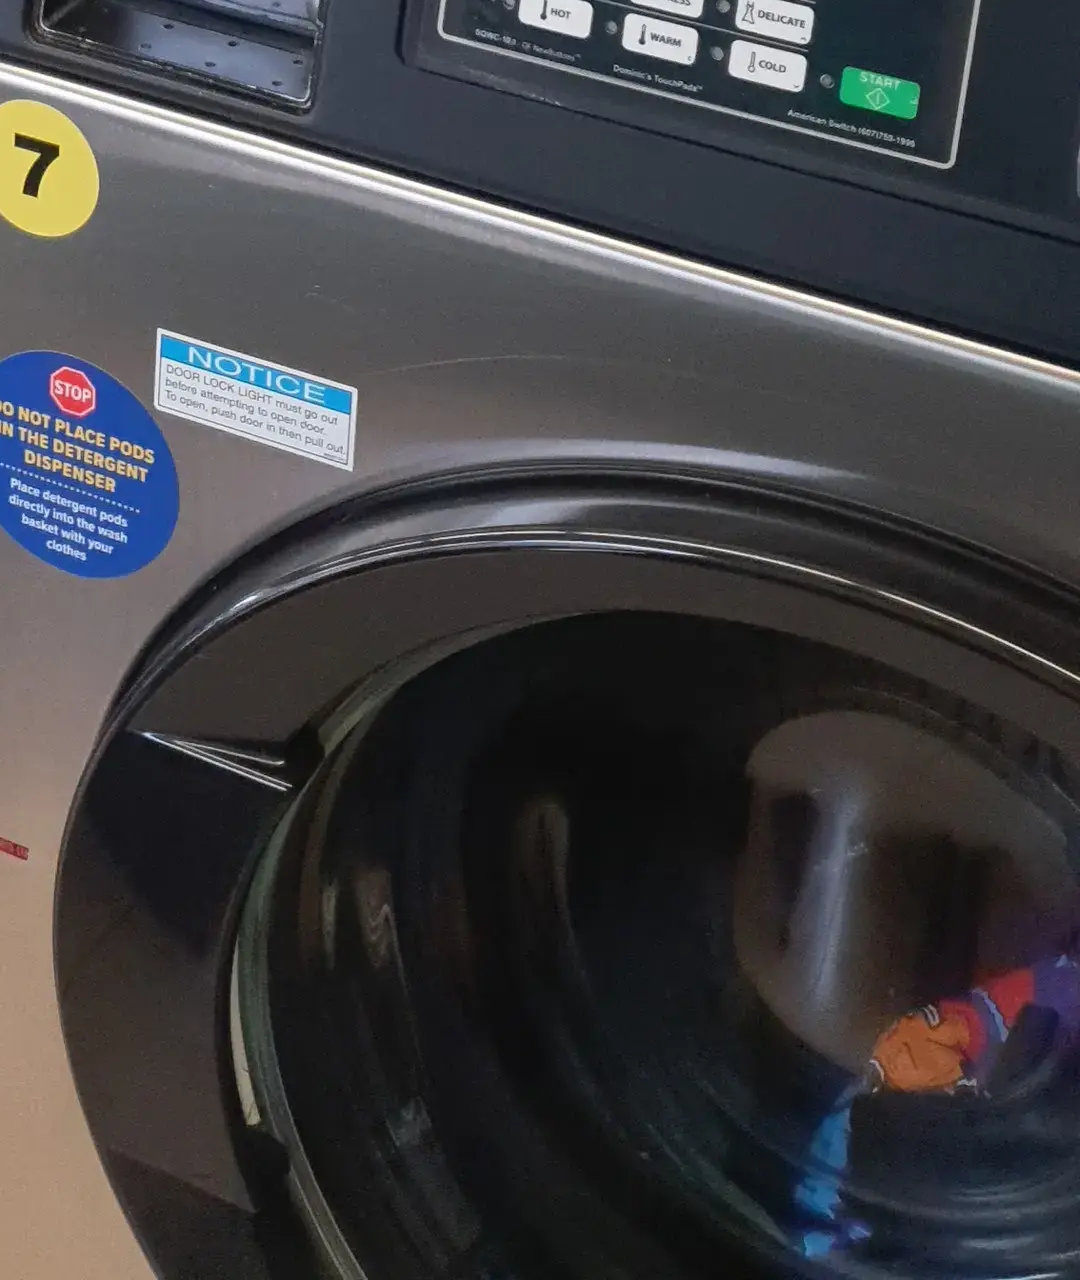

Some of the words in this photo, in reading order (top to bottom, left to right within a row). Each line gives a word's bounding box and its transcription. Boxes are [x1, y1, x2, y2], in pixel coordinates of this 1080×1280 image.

[551, 8, 571, 19] HOT
[758, 10, 806, 29] DELICATE
[650, 32, 681, 47] WARM
[758, 60, 786, 73] COLD
[858, 69, 902, 91] START
[14, 133, 60, 198] 7
[54, 379, 92, 403] STOP
[166, 364, 200, 382] DOOR
[204, 376, 234, 393] LOCK
[238, 387, 273, 404] LIGHT
[276, 400, 302, 415] must
[305, 409, 318, 419] go
[321, 415, 337, 425] out
[189, 347, 325, 405] NOTICE
[165, 377, 197, 395] before
[200, 390, 254, 415] attempting
[258, 407, 267, 416] to
[270, 412, 297, 426] open
[165, 390, 177, 401] To
[180, 397, 208, 412] open,
[211, 407, 236, 420] push
[240, 415, 263, 428] door
[266, 424, 275, 432] in
[279, 426, 301, 441] then
[305, 436, 323, 448] pull
[18, 406, 51, 428] NOT
[55, 418, 105, 447] PLACE
[109, 437, 154, 464] PODS
[18, 426, 48, 449] THE
[53, 438, 148, 482] DETERGENT
[24, 449, 116, 492] DISPENSER
[9, 494, 50, 518] directly
[52, 508, 74, 524] into
[76, 517, 96, 532] the
[98, 526, 128, 543] wash
[10, 478, 40, 497] Place
[42, 490, 97, 517] detergent
[99, 511, 128, 527] pods
[21, 513, 59, 535] basket
[61, 529, 85, 544] with
[87, 539, 114, 554] your
[46, 540, 87, 561] clothes
